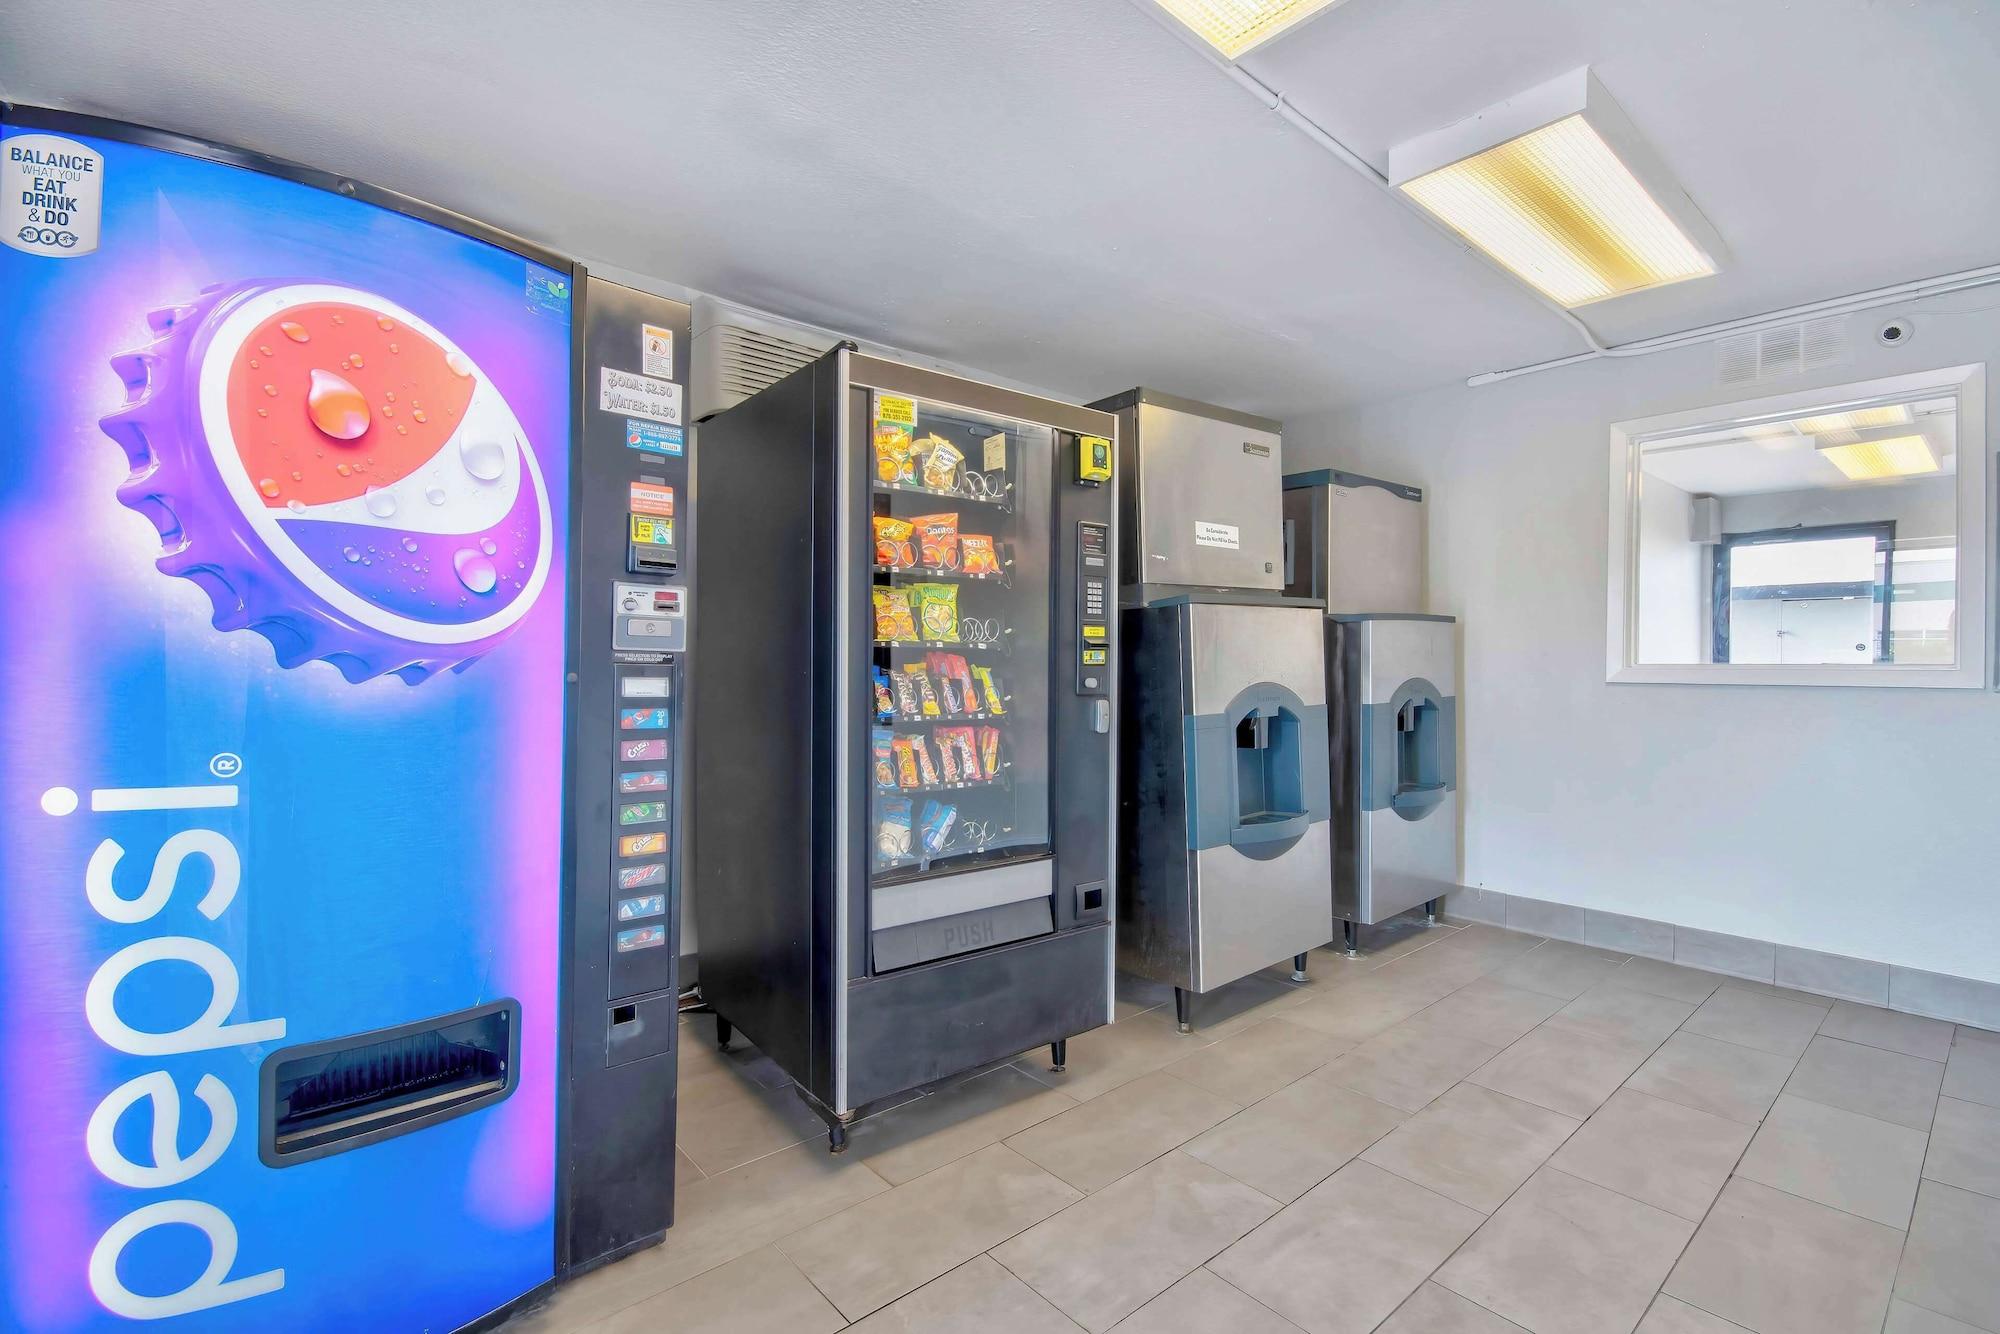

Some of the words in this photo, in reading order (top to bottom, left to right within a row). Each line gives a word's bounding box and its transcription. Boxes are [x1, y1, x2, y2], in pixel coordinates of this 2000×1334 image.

[11, 147, 94, 172] BALANCE
[22, 164, 54, 177] WHAT
[59, 170, 81, 182] YOU
[22, 191, 77, 212] DRINK
[28, 208, 40, 222] &
[45, 210, 69, 226] DO
[645, 381, 673, 398] $2.50
[650, 402, 676, 418] $1.50
[641, 491, 665, 500] NOTICE
[927, 526, 955, 535] Doritos
[628, 741, 650, 758] Crush
[632, 833, 655, 852] Crush
[944, 919, 994, 950] PUSH
[40, 785, 287, 1320] pepsi
